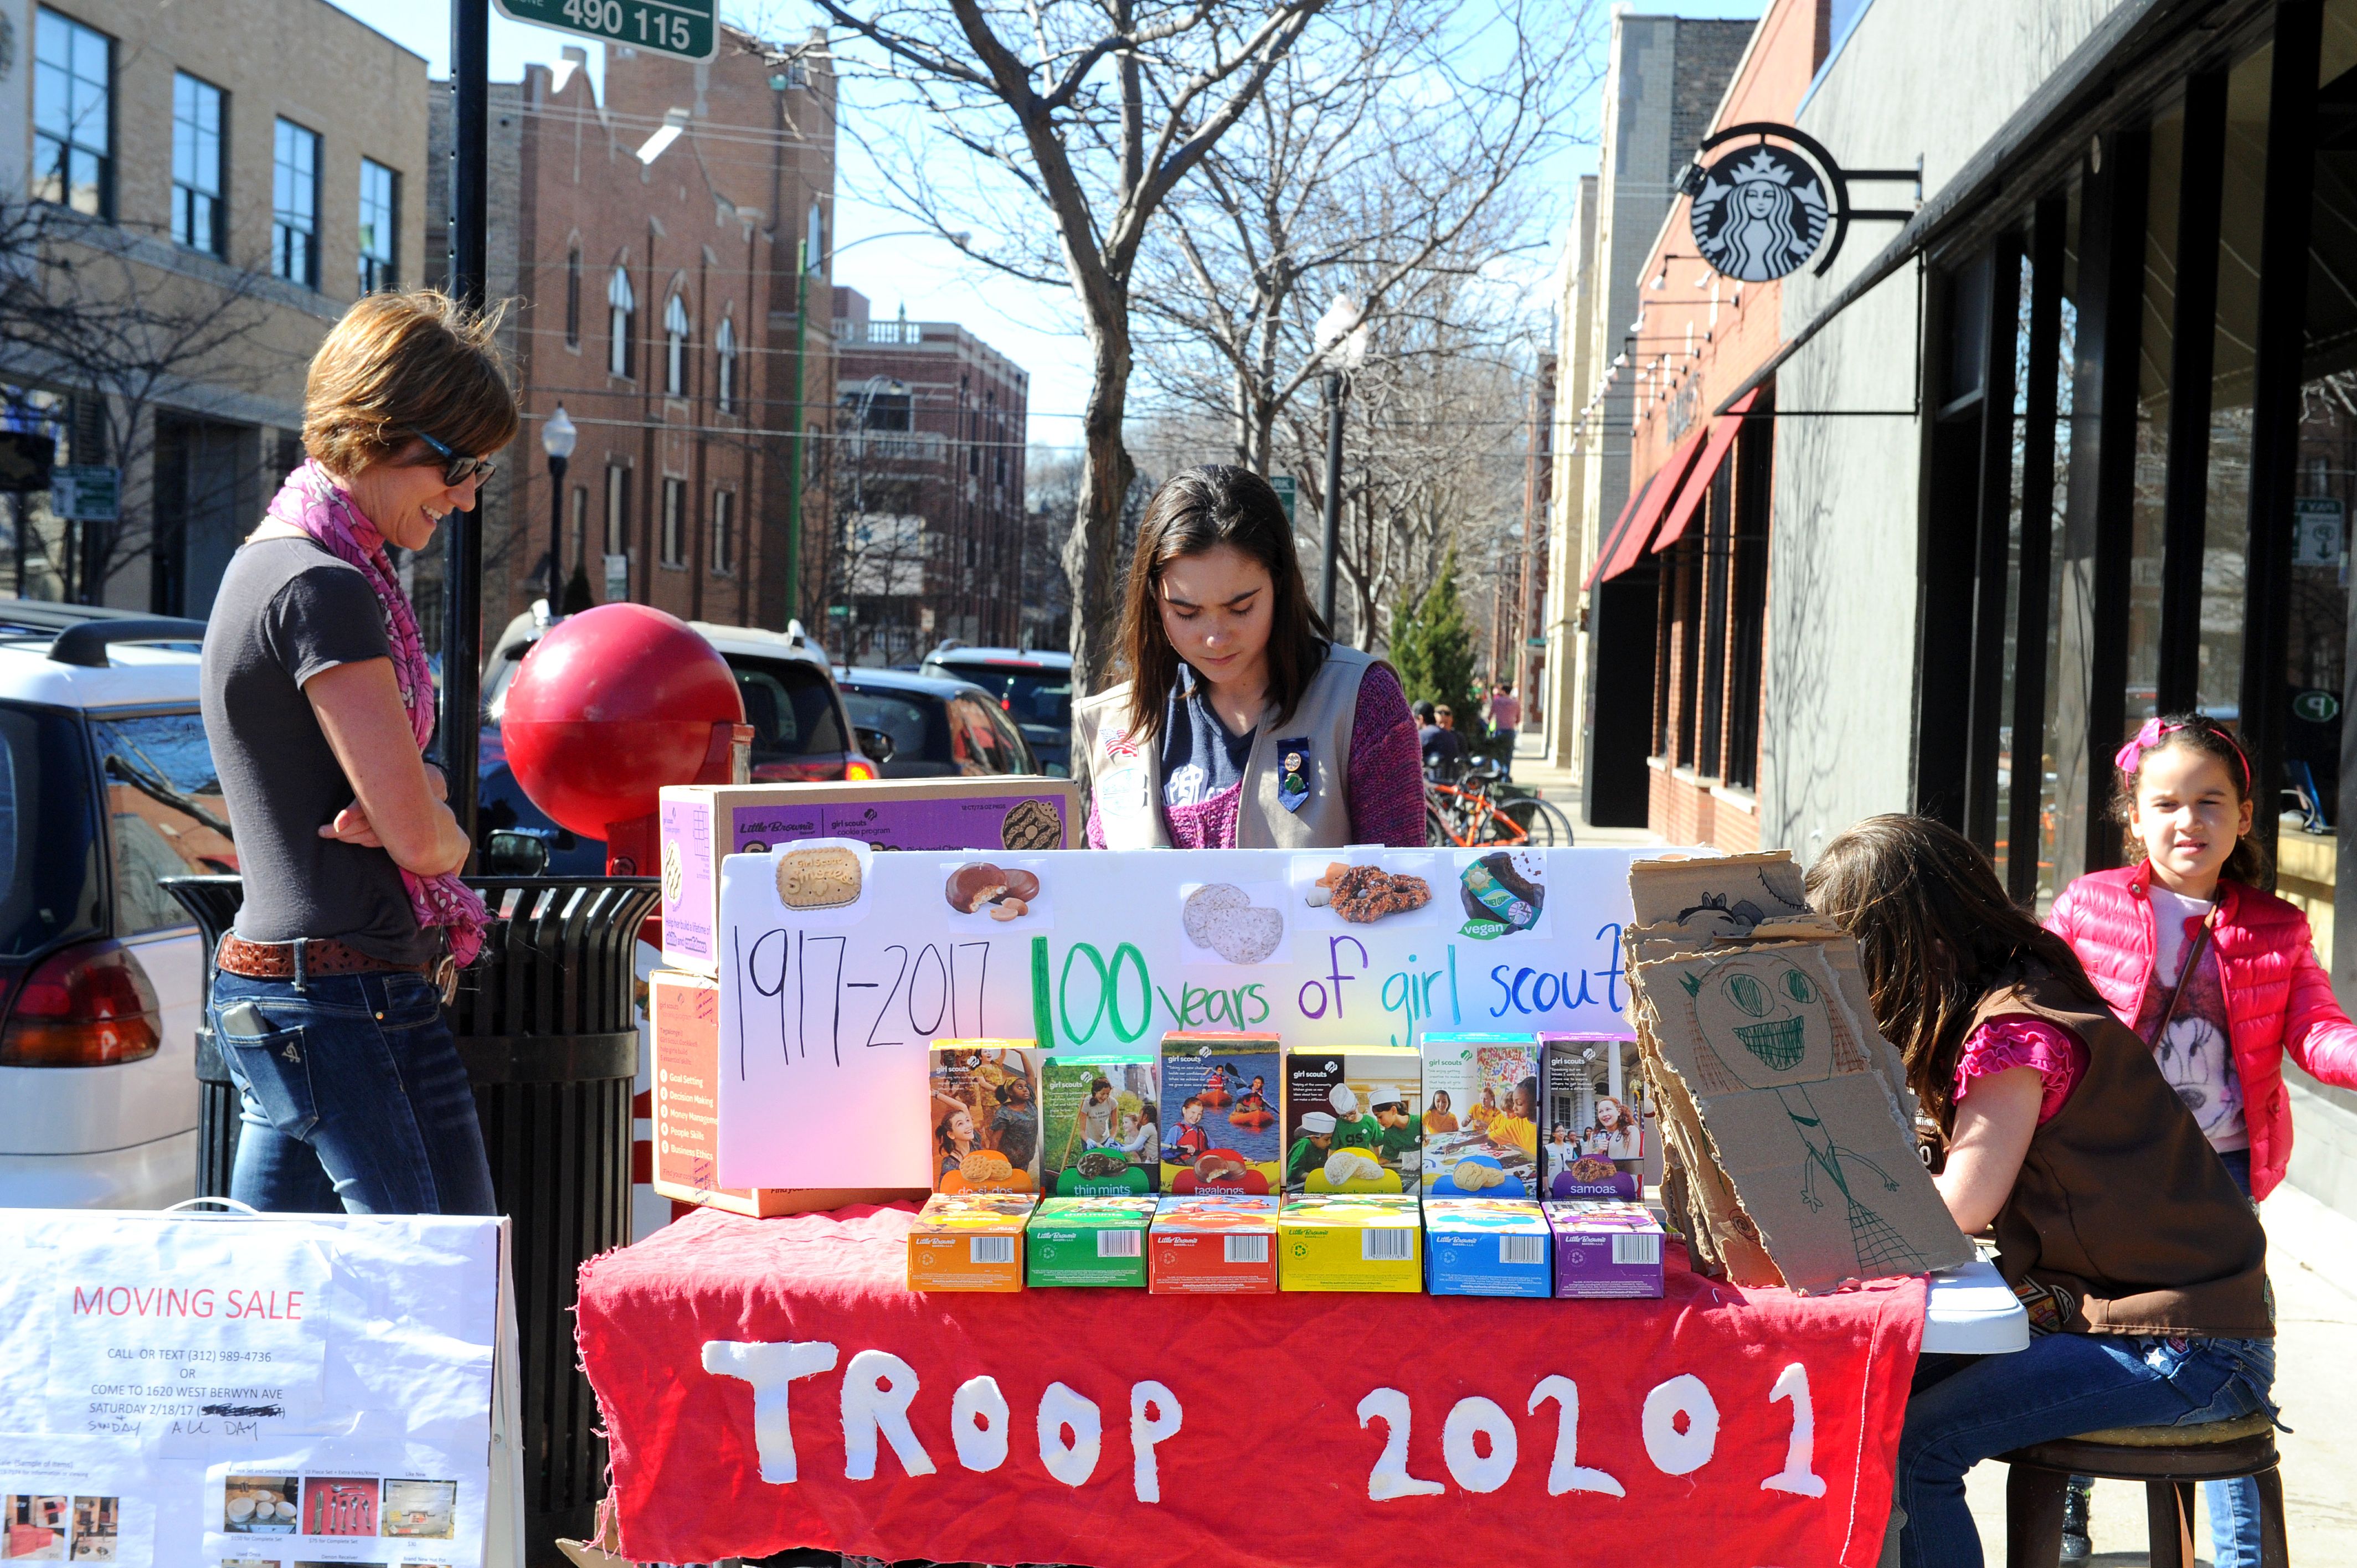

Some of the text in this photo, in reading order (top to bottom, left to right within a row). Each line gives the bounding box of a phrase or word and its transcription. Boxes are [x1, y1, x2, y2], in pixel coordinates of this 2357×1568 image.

[562, 0, 691, 50] 490 115
[739, 821, 814, 834] Little Brownie
[832, 821, 843, 830] girl
[861, 827, 891, 837] program
[1464, 924, 1504, 936] vegan
[734, 925, 990, 1081] 1917-2017
[1031, 935, 1151, 1049] 100
[1156, 981, 1270, 1032] years
[1298, 935, 1368, 1020] of
[1381, 943, 1462, 1048] girl
[1168, 1055, 1179, 1064] girl
[1429, 1059, 1440, 1067] girl
[1551, 1057, 1563, 1066] girl
[936, 1065, 948, 1074] girl
[1293, 1070, 1305, 1079] girl
[670, 1072, 704, 1089] Goal Setting
[1049, 1080, 1061, 1090] girl
[670, 1091, 693, 1102] Decision
[694, 1095, 714, 1107] Making
[670, 1108, 718, 1125] Money Manageme
[670, 1127, 704, 1141] People Skills
[1345, 1133, 1363, 1146] gs
[671, 1144, 696, 1157] Business
[696, 1147, 713, 1160] Ethics
[1074, 1184, 1131, 1195] thin mints
[74, 1286, 304, 1320] MOVING SALE
[107, 1348, 272, 1364] CALL OR TEXT (312) 989-4736
[179, 1368, 196, 1379] OR
[91, 1384, 283, 1400] COME TO 1620 WEST BERWYN AVE
[89, 1402, 147, 1415] SATURDAY
[150, 1404, 194, 1416] 2/18/17
[701, 1340, 1827, 1504] TROOP 20201
[224, 1421, 259, 1441] DAY
